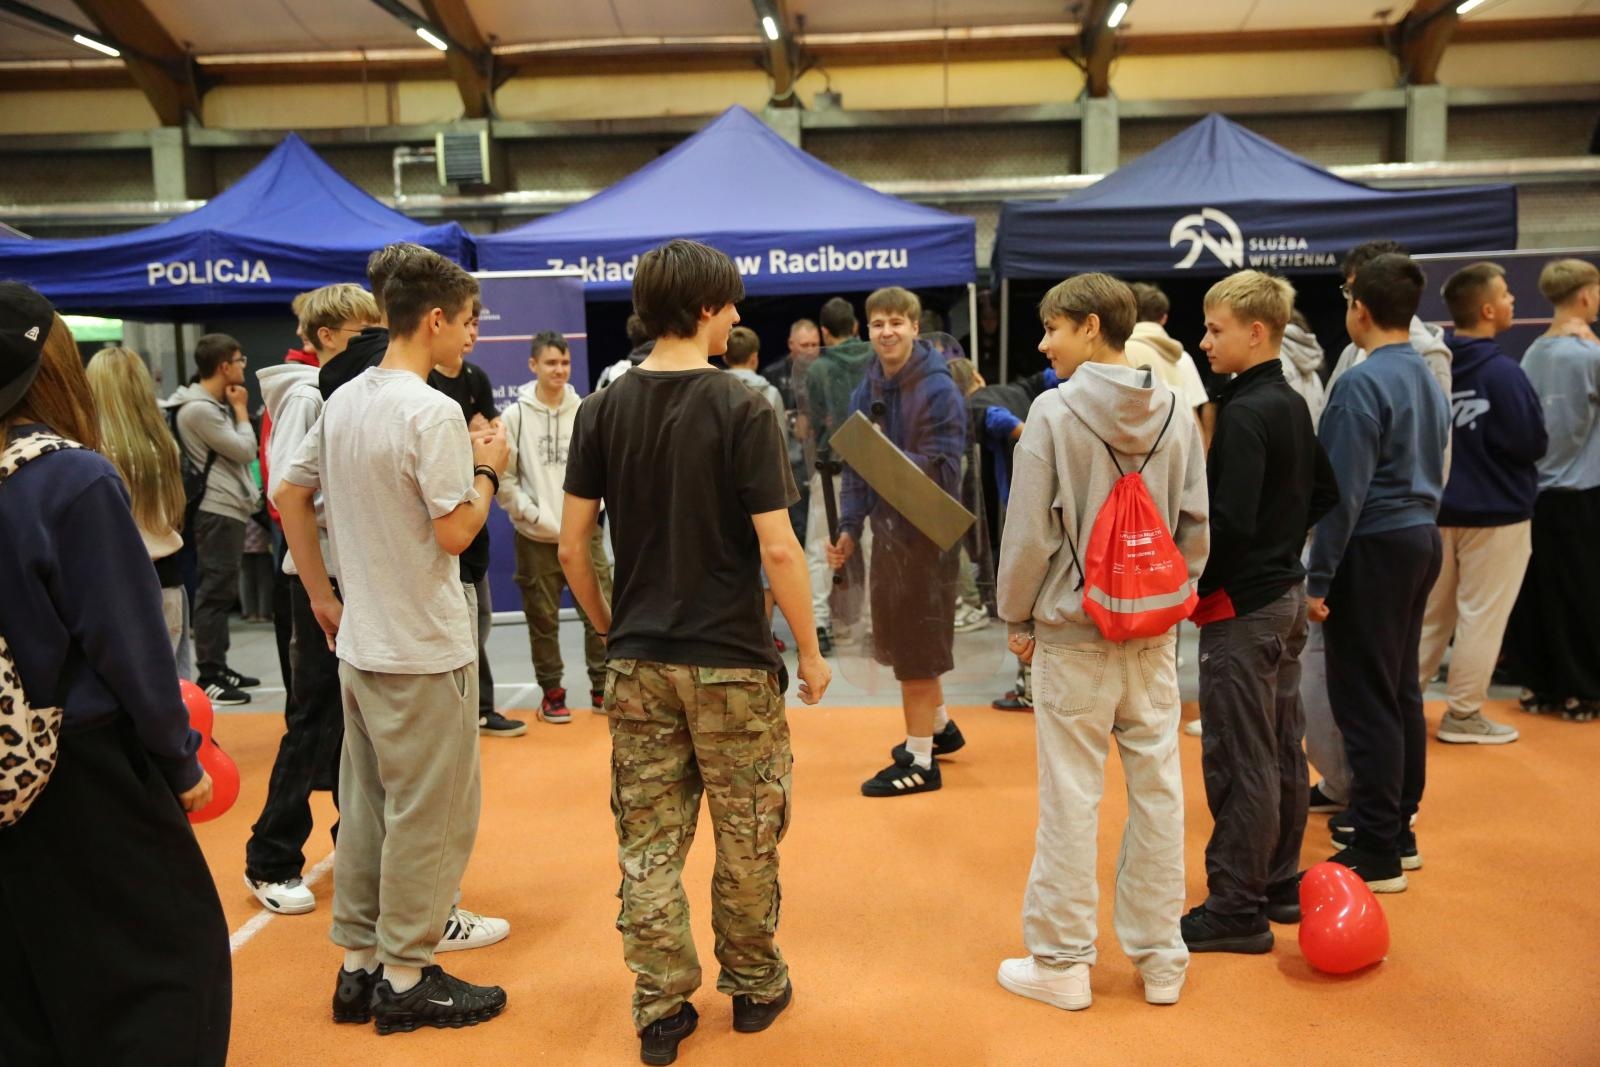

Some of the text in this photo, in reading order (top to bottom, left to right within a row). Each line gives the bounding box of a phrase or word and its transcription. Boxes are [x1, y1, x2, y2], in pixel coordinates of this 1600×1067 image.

[147, 259, 271, 286] POLICJA
[735, 255, 761, 275] w
[769, 245, 908, 274] Raciborzu
